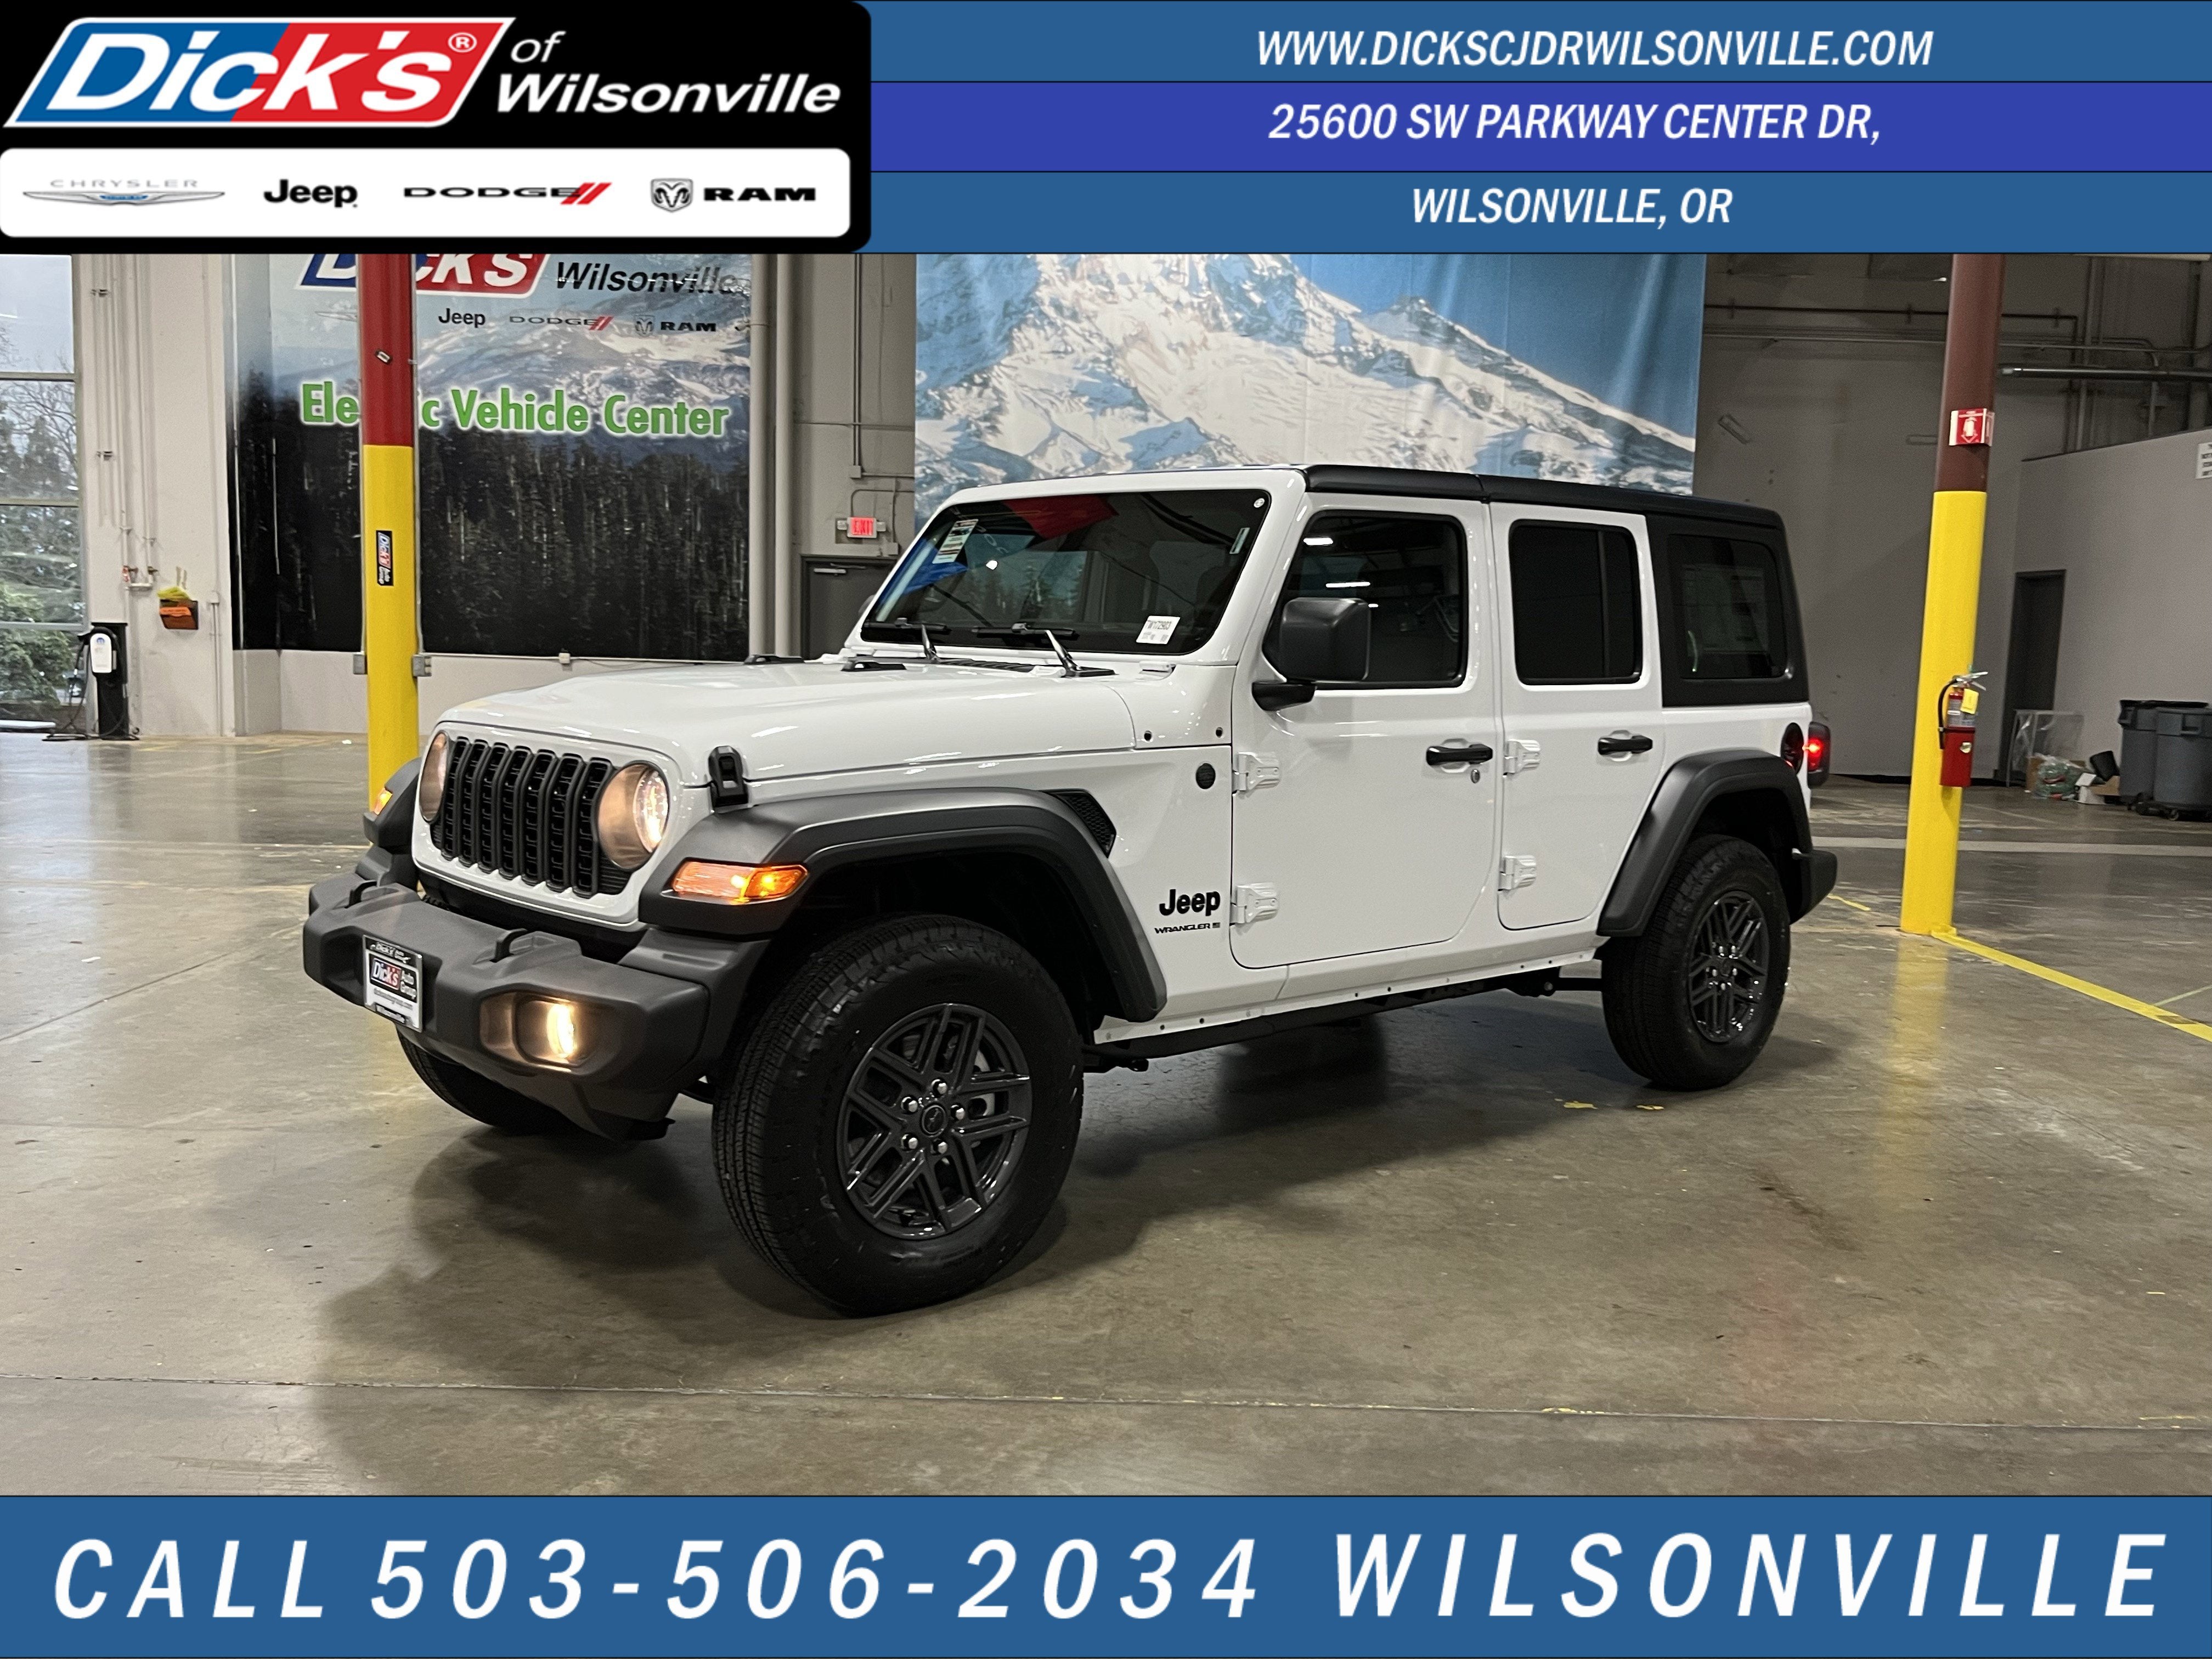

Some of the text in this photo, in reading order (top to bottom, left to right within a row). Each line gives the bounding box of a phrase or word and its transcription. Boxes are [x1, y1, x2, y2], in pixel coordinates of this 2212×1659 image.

[438, 308, 486, 326] Jeep
[509, 316, 599, 326] DODGE
[661, 321, 717, 332] RAM
[451, 388, 589, 432] Vehicle
[605, 395, 729, 436] Center
[853, 519, 873, 535] EXIT
[1159, 889, 1221, 917] Jeep
[1154, 923, 1211, 934] WRANGLER
